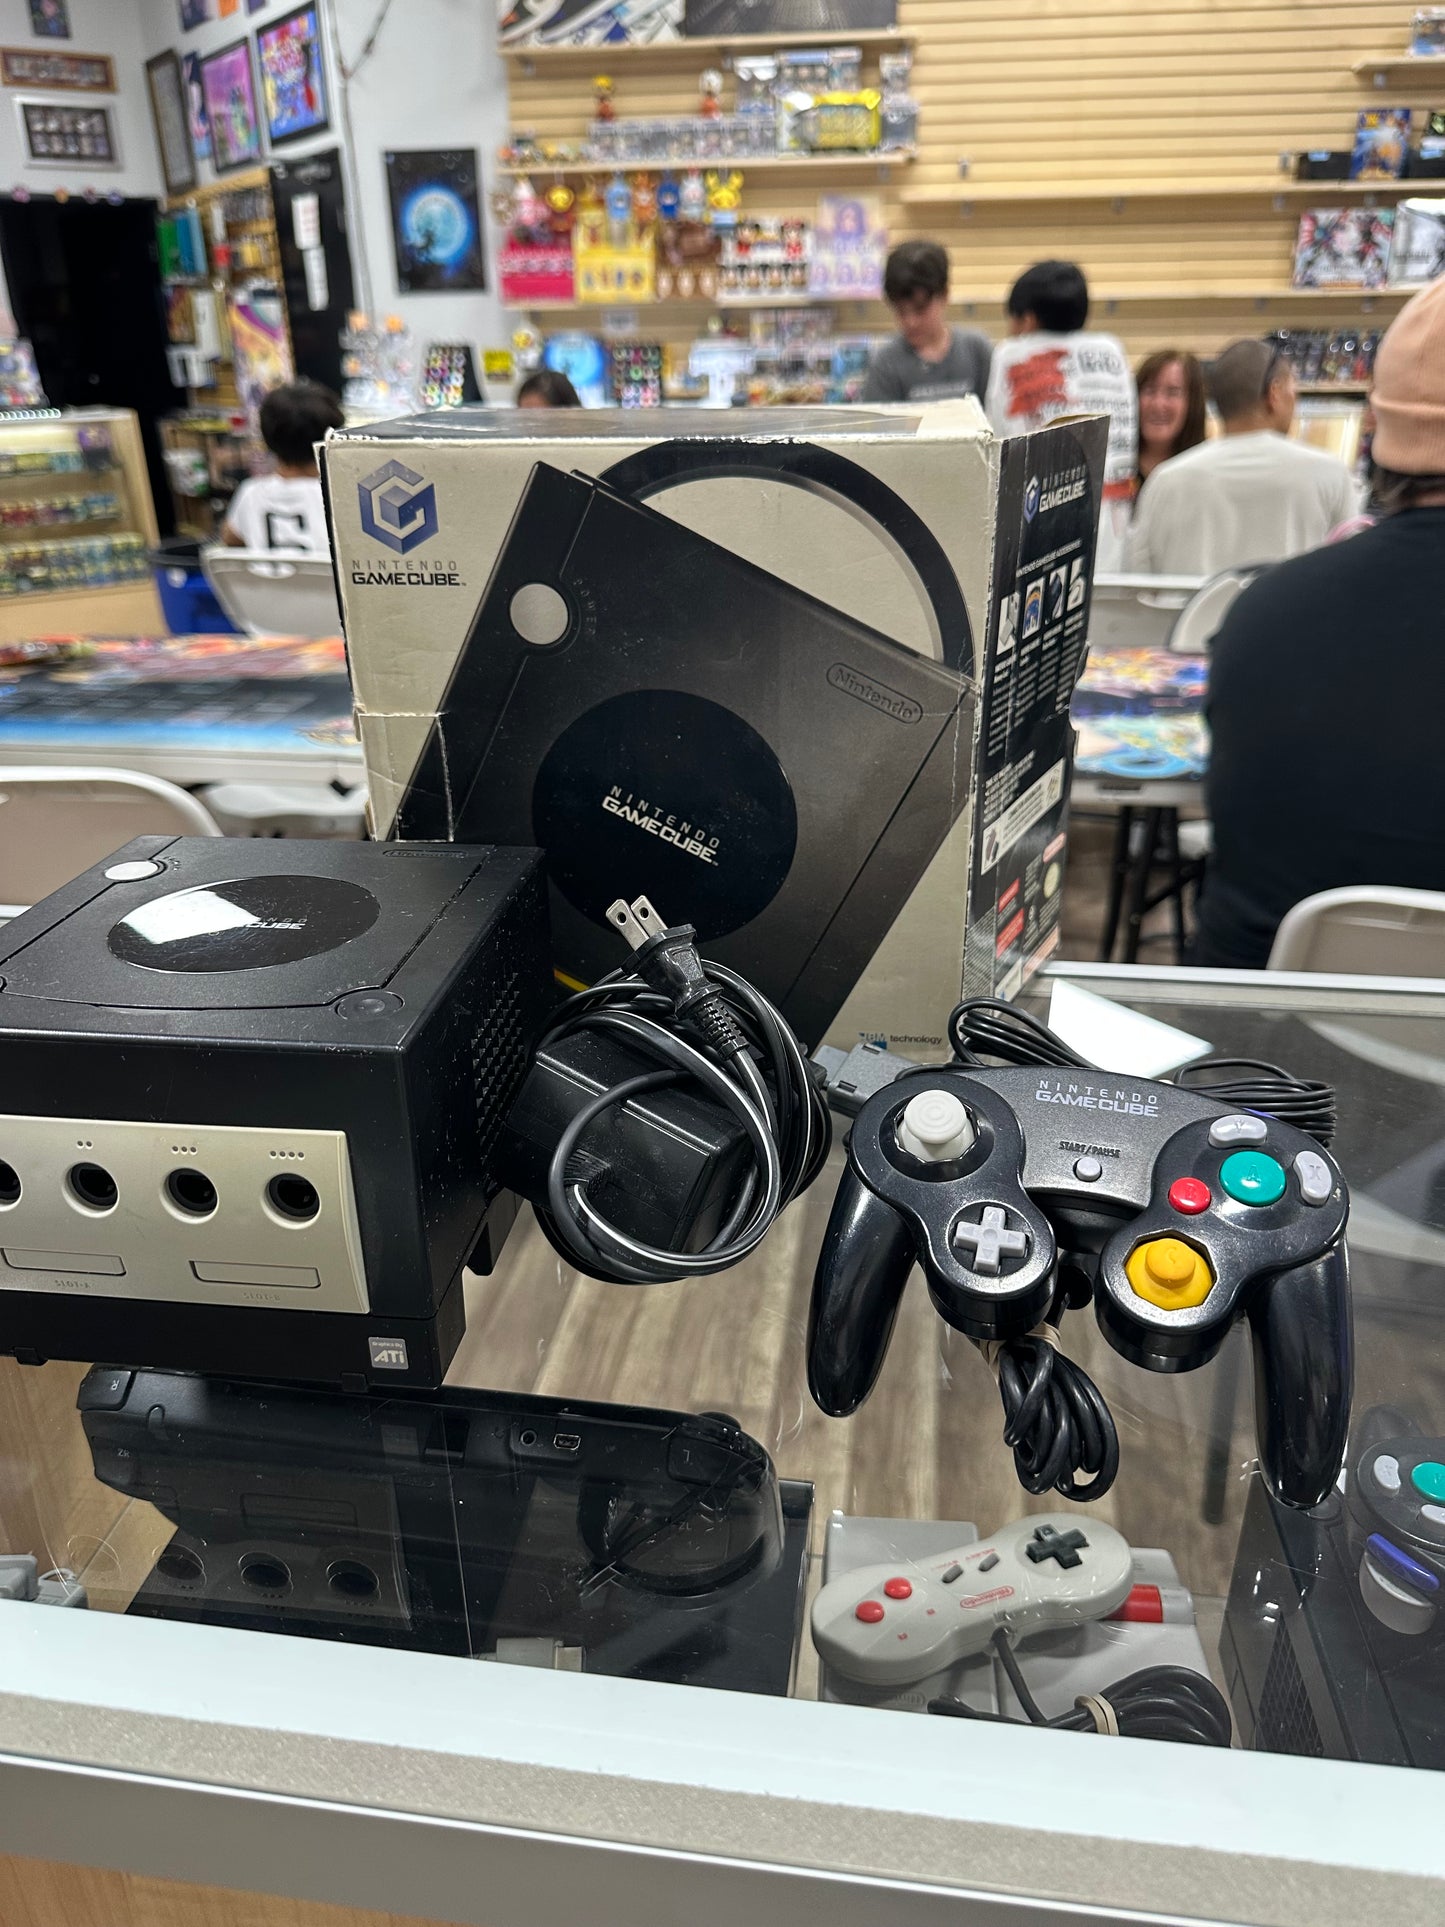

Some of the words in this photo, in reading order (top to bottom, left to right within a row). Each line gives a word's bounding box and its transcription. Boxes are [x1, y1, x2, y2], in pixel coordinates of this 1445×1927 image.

[1041, 463, 1087, 492] NINTENDO
[1039, 478, 1087, 513] GAMECUBE
[352, 560, 458, 571] NINTENDO
[352, 572, 460, 586] GAMECUBE
[835, 667, 913, 719] Nintendo
[610, 785, 720, 850] NINTENDO
[602, 795, 717, 864] GAMECUBE
[890, 1034, 942, 1045] technology
[1039, 1080, 1158, 1104] NINTENDO
[1035, 1090, 1159, 1118] GAMECUBE
[1059, 1140, 1121, 1158] START/PAUSE
[1246, 1164, 1262, 1184] A
[1308, 1164, 1322, 1181] X
[110, 1379, 120, 1391] R
[117, 1448, 131, 1458] ZR
